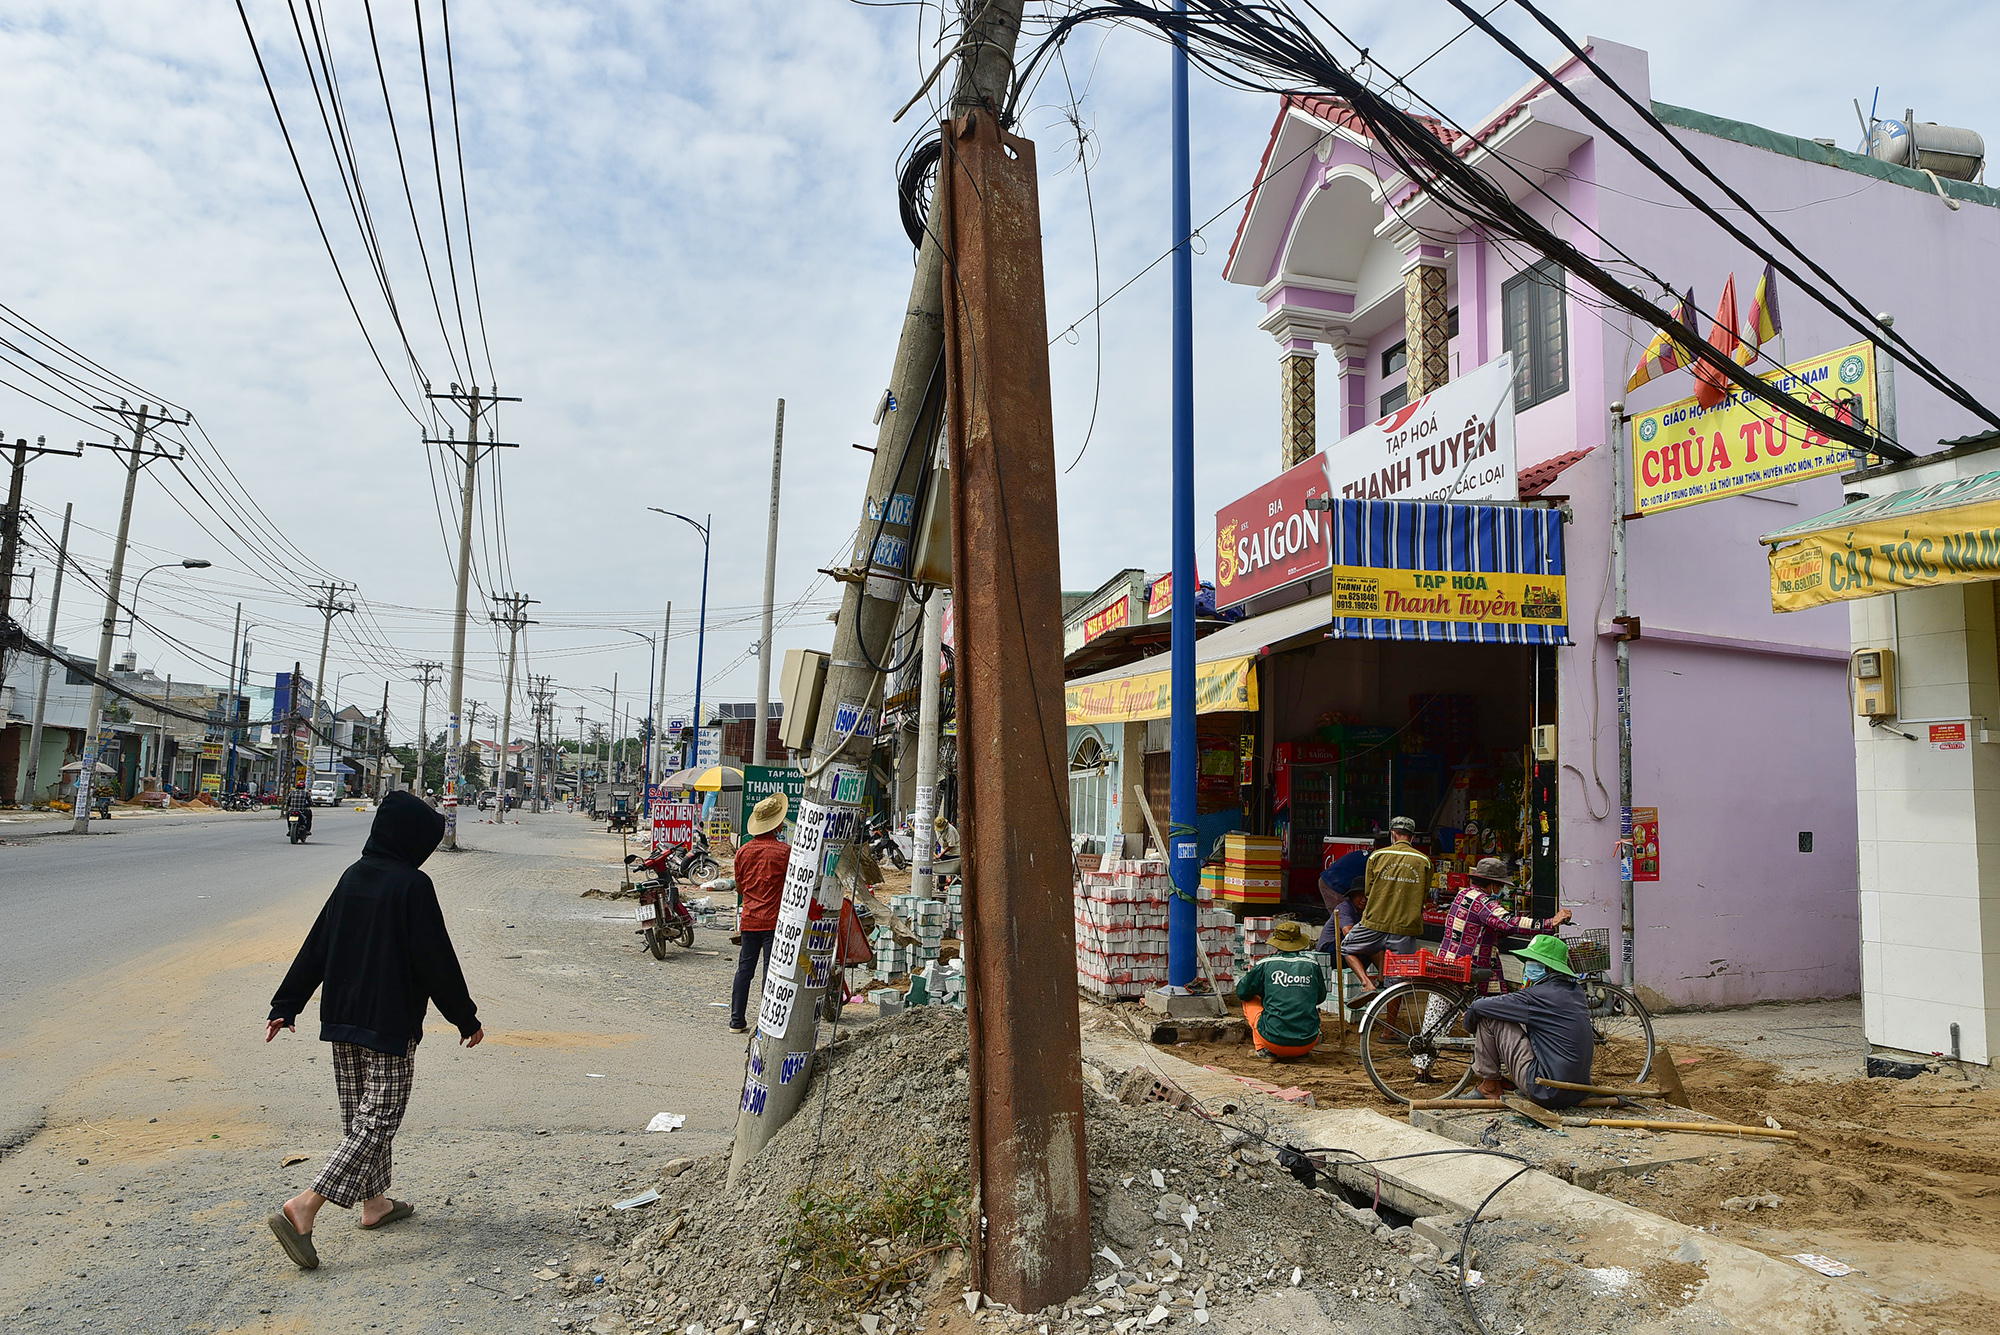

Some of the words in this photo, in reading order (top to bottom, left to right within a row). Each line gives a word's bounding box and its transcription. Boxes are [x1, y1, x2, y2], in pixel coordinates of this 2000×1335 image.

[1663, 408, 1686, 426] GIÁO
[1802, 366, 1829, 386] NAM
[1386, 431, 1407, 456] TẠP
[1411, 411, 1438, 443] HOÁ
[1416, 414, 1497, 481] TUYỀN
[1642, 427, 1732, 487] CHÙA
[1456, 474, 1476, 494] CÁC
[1479, 464, 1504, 486] LOẠI
[1671, 488, 1688, 500] TRUNG
[1732, 474, 1744, 486] TAM
[1763, 465, 1783, 480] HUYỆN
[1815, 456, 1825, 467] TP.
[1268, 498, 1283, 517] BIA
[1238, 509, 1319, 576] SAIGON
[1829, 531, 1874, 592] CẮT
[1880, 529, 1938, 582] TÓC
[1413, 574, 1446, 592] TẠP
[1452, 573, 1488, 590] HÓA
[1384, 590, 1450, 615] Thanh
[1457, 589, 1518, 620] Tuyền
[1080, 684, 1114, 717] Thanh
[1119, 678, 1155, 719] Tuyền
[768, 770, 785, 778] TẠP
[746, 781, 784, 793] THANH
[654, 806, 675, 824] GẠCH
[676, 806, 692, 820] MEN
[808, 807, 824, 826] GÓP
[672, 823, 691, 842] NƯỚC
[797, 865, 814, 884] GÓP
[784, 922, 801, 941] GÓP
[1271, 970, 1311, 987] Ricons
[776, 983, 794, 1002] GÓP
